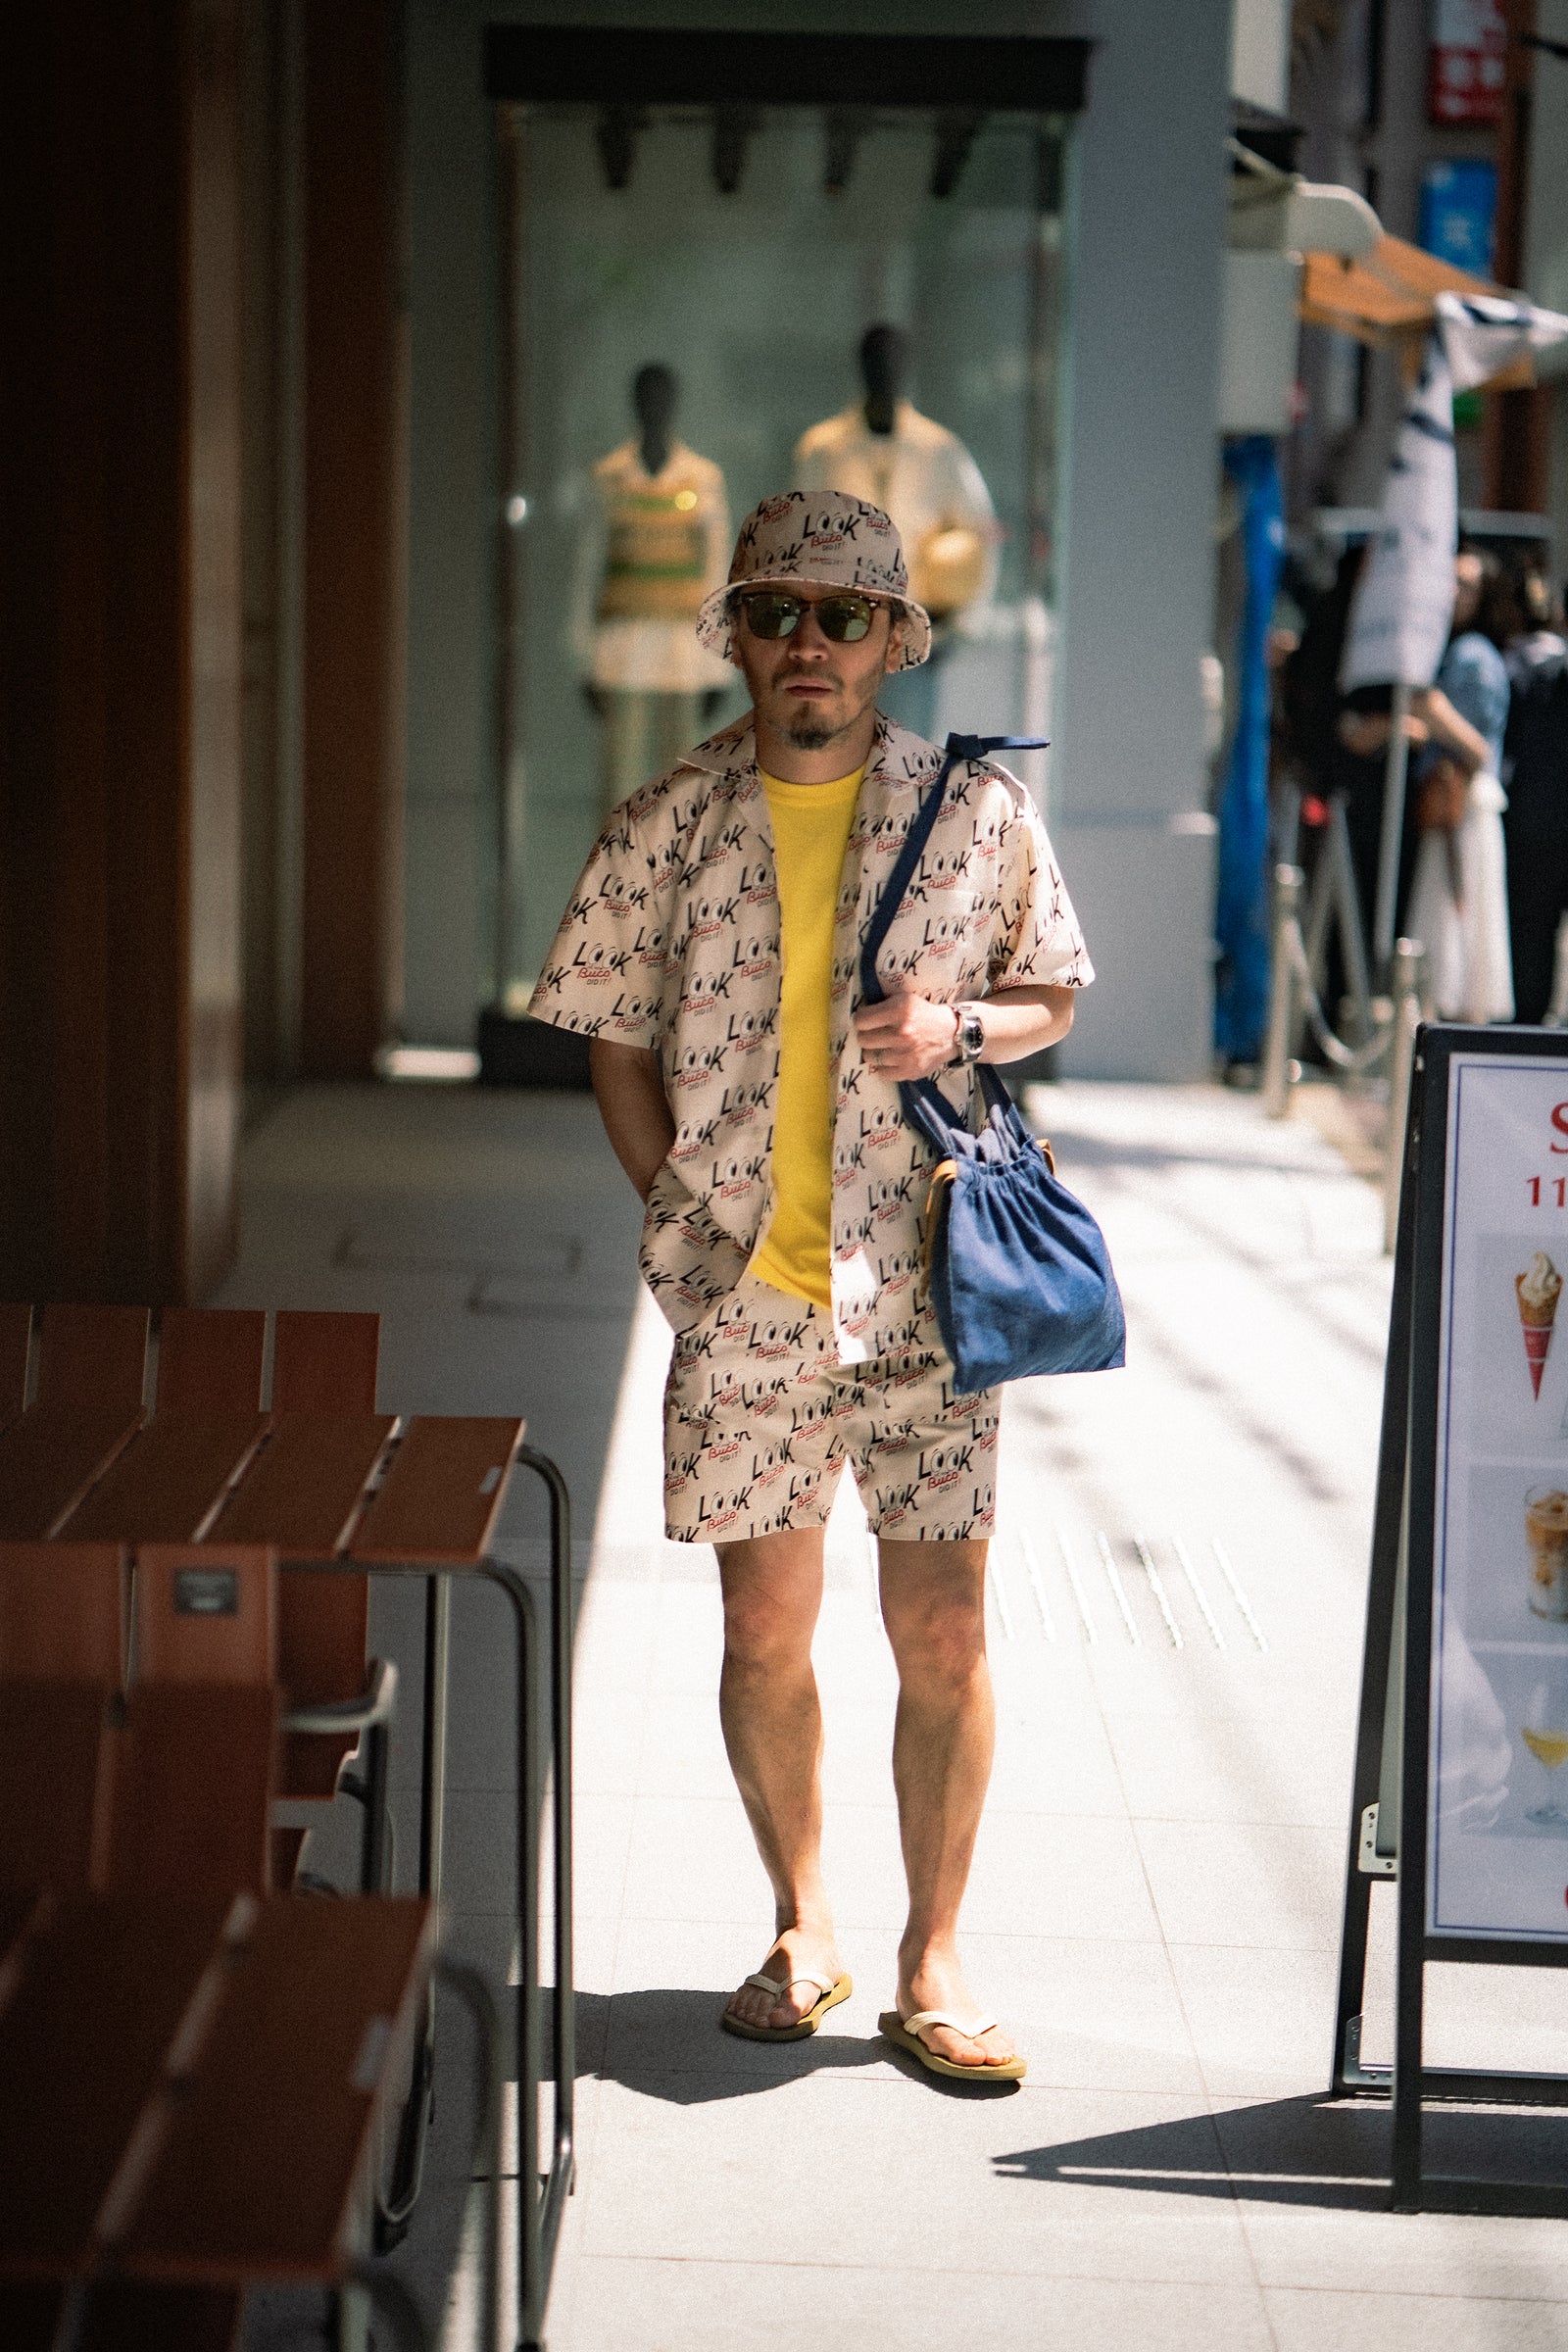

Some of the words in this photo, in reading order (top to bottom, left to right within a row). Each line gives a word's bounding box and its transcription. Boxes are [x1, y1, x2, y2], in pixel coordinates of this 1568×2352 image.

[803, 511, 860, 540] LOOK
[810, 534, 842, 549] Buco
[706, 849, 727, 860] uco
[876, 837, 906, 853] Buco
[919, 851, 972, 881] LOOK
[599, 873, 650, 910] LOOK
[928, 875, 956, 889] Buco
[604, 900, 630, 912] Buco
[688, 897, 740, 929] LOOK
[691, 922, 721, 939] Buco
[923, 916, 970, 947] LOOK
[572, 941, 633, 976] LOOK
[929, 941, 956, 956] Buco
[576, 967, 611, 979] Buco
[741, 960, 771, 978] Buco
[881, 950, 924, 976] OOK
[679, 971, 734, 1004] LOOK
[611, 993, 664, 1020] LOOK
[683, 997, 714, 1013] Buco
[727, 1007, 778, 1042] LOOK
[735, 1035, 763, 1053] Buco
[672, 1046, 729, 1076] LOOK
[677, 1070, 709, 1088] Buco
[720, 1082, 773, 1115] LOOK
[726, 1107, 754, 1126] Buco
[675, 1119, 720, 1146] OOK
[868, 1130, 899, 1148] Buco
[711, 1156, 766, 1188] LOOK
[835, 1169, 856, 1187] Buco
[720, 1181, 751, 1199] Buco
[868, 1176, 912, 1211] LOOK
[877, 1203, 901, 1222] Buco
[678, 1225, 706, 1246] Buco
[682, 1206, 731, 1250] LOOK
[878, 1250, 919, 1286] LOOK
[674, 1285, 701, 1304] Buco
[678, 1264, 724, 1308] LOOK
[887, 1276, 910, 1295] Buco
[723, 1325, 750, 1339] Buc
[748, 1320, 809, 1348] LOOK
[847, 1317, 869, 1335] Buco
[875, 1320, 923, 1357] LOOK
[756, 1345, 788, 1360] Buco
[885, 1351, 939, 1379] LOOK
[895, 1369, 925, 1387] Buco
[742, 1376, 789, 1409] LOOK
[755, 1396, 776, 1417] Buco
[953, 1398, 979, 1419] Buco
[797, 1421, 823, 1441] Buco
[870, 1418, 920, 1445] LOOK
[708, 1444, 739, 1460] Buco
[877, 1438, 907, 1453] Buco
[752, 1438, 795, 1481] LOOK
[918, 1446, 974, 1480] LOOK
[760, 1464, 784, 1489] Buco
[928, 1471, 958, 1491] Buco
[698, 1486, 754, 1522] LOOK
[875, 1484, 920, 1514] LOOK
[707, 1511, 736, 1532] Buco
[884, 1509, 905, 1526] Buco
